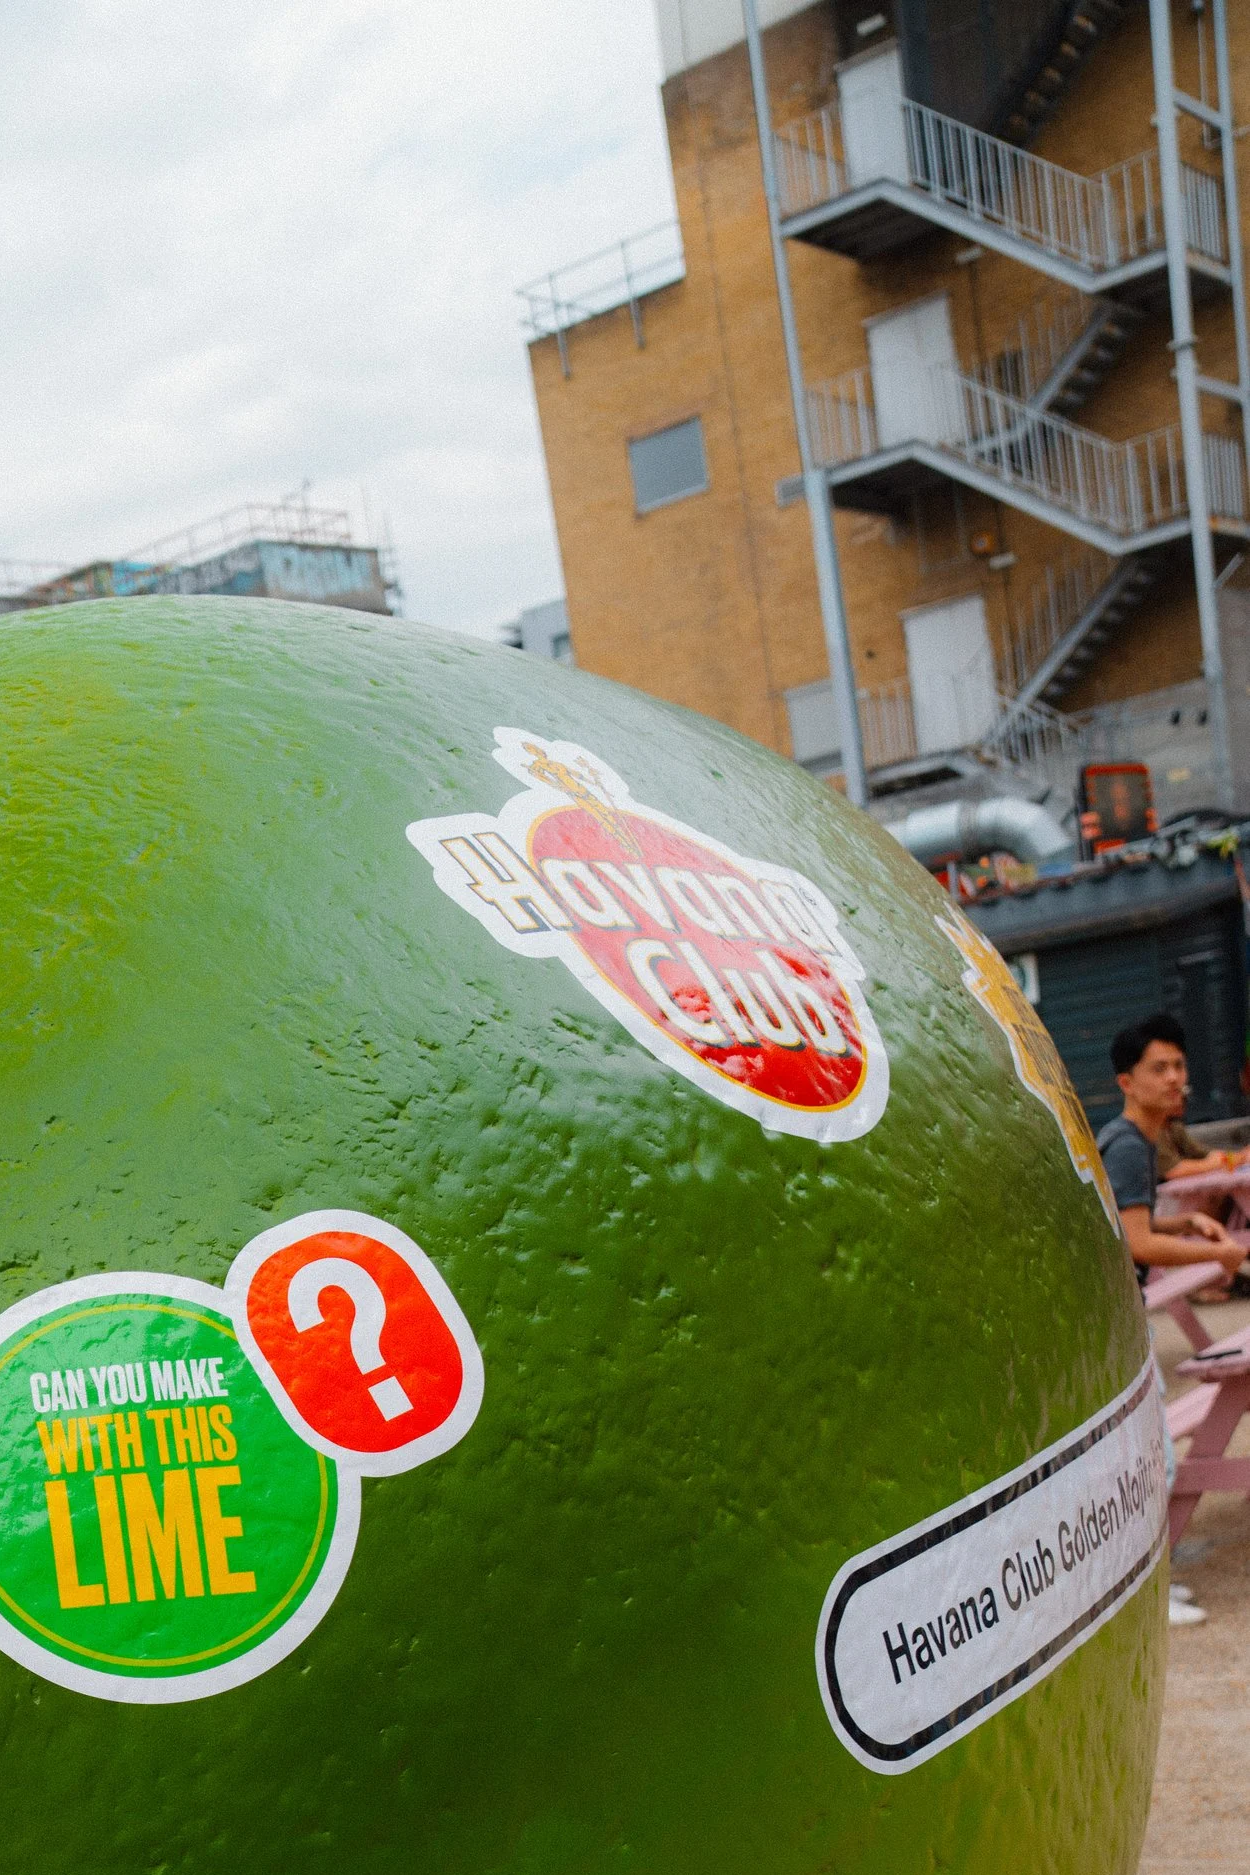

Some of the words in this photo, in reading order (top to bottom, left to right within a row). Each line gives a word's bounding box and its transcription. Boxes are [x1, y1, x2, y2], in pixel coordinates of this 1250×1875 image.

[439, 831, 843, 957] Havana
[625, 937, 854, 1058] Club
[30, 1367, 96, 1413] CAN
[91, 1361, 147, 1406] YOU
[150, 1357, 229, 1401] MAKE
[287, 1257, 414, 1422] ?
[36, 1408, 144, 1475] WITH
[146, 1404, 238, 1466] THIS
[44, 1465, 257, 1610] LIME
[882, 1587, 1000, 1684] Havana
[1002, 1539, 1056, 1611] Club
[1058, 1499, 1120, 1572] Golden
